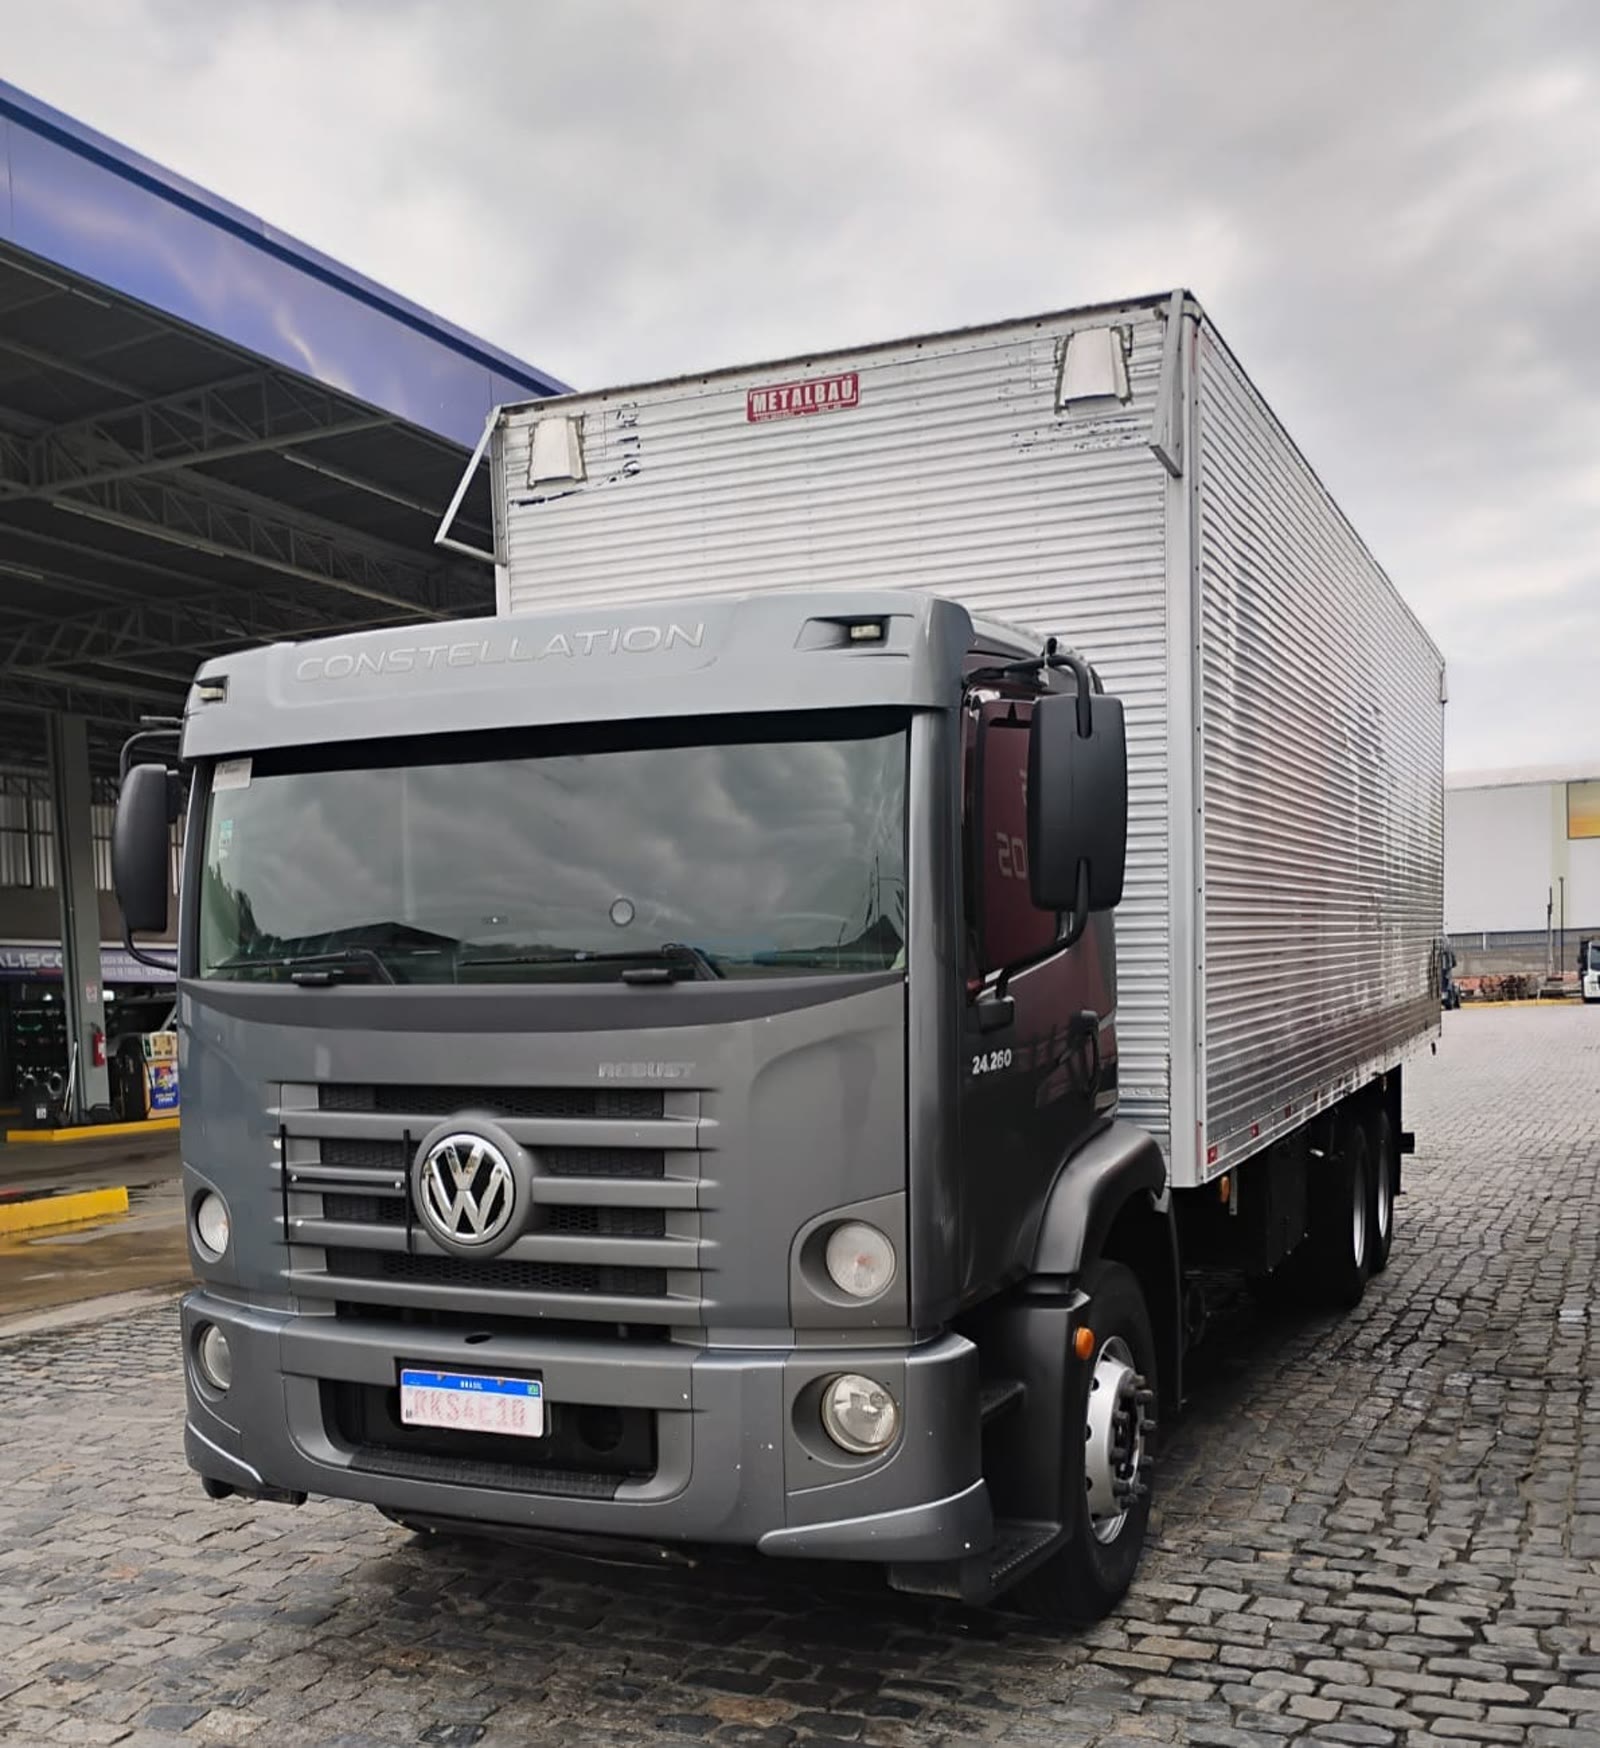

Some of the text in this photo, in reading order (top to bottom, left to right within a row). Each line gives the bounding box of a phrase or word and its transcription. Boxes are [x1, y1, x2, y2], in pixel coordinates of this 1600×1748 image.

[296, 623, 705, 682] CONSTELLATION
[598, 1062, 697, 1078] ROBUST
[972, 1048, 1012, 1075] 24.260
[460, 1380, 483, 1390] BRASIL
